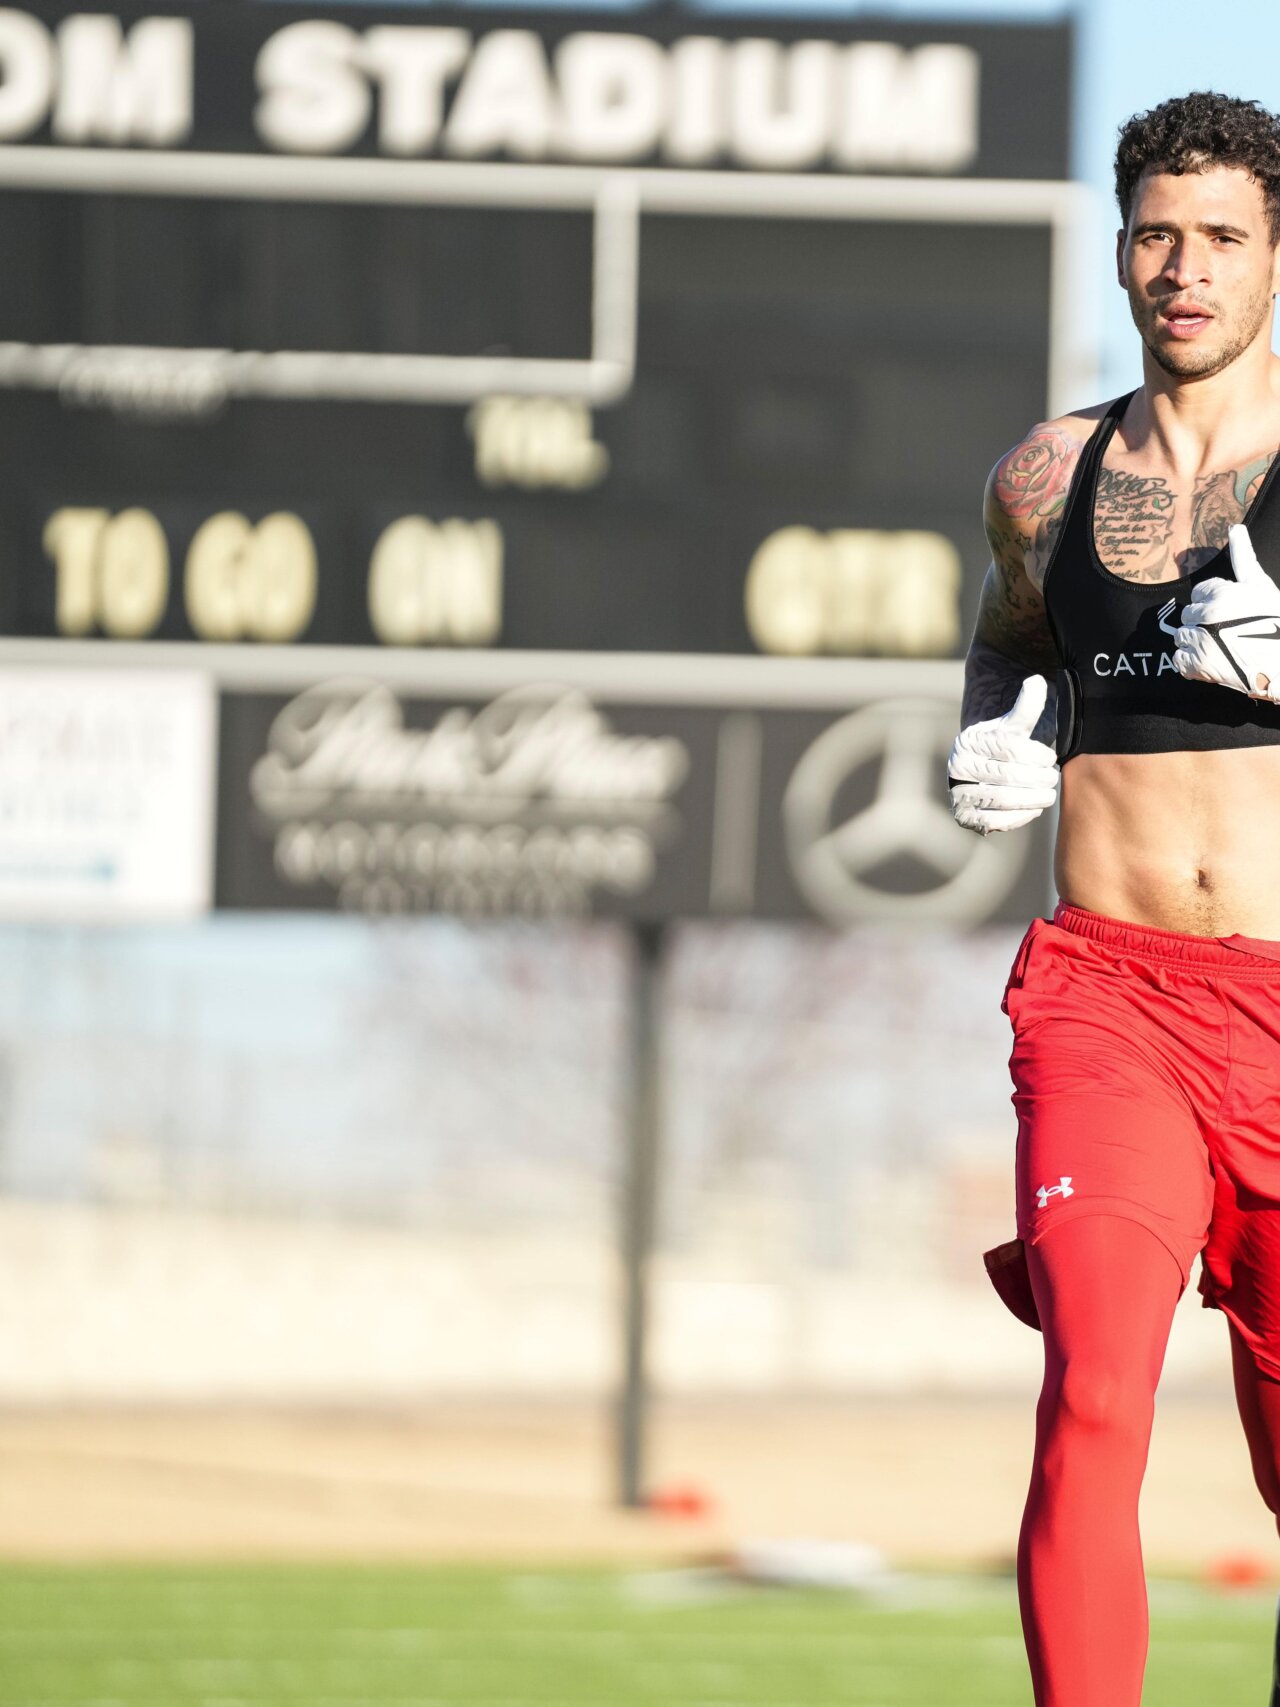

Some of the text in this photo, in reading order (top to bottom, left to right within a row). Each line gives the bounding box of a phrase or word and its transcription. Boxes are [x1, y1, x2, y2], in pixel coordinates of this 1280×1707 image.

[255, 19, 979, 172] STADIUM
[42, 507, 170, 638] TO
[184, 511, 318, 642] GO
[368, 515, 504, 646] ON
[1093, 652, 1180, 677] CATA
